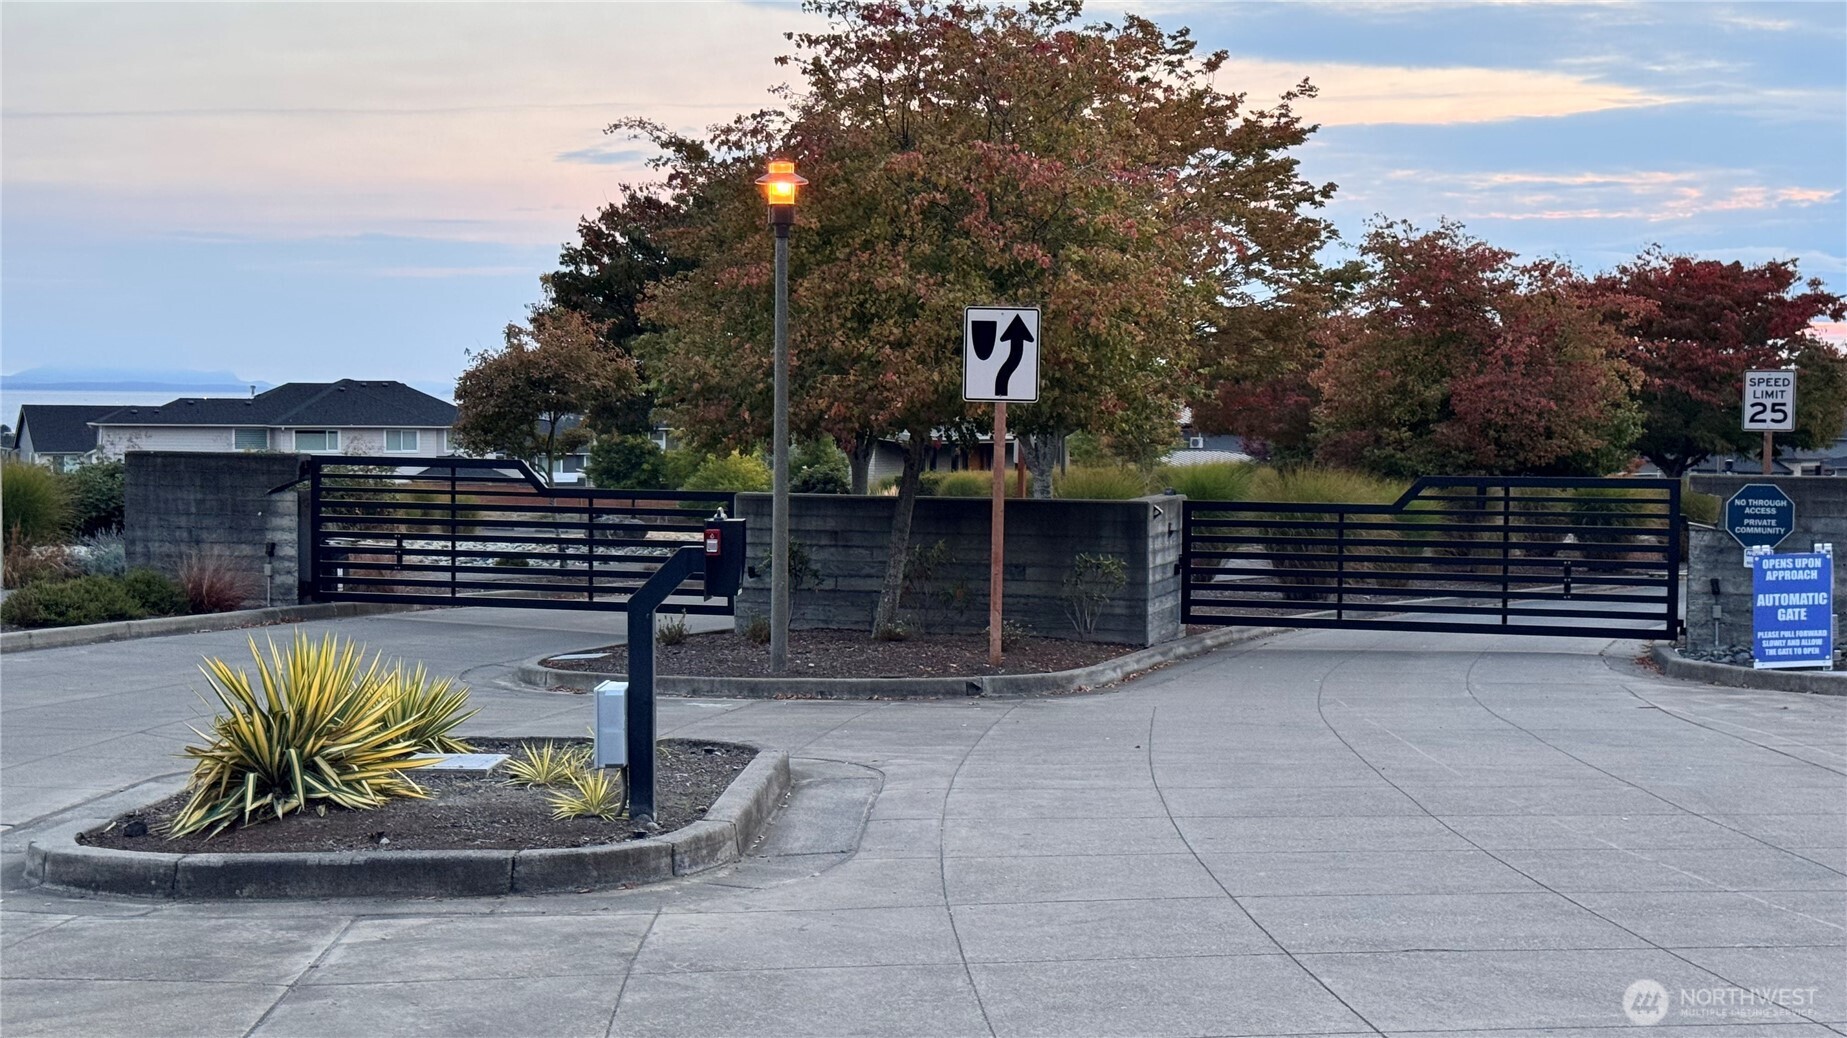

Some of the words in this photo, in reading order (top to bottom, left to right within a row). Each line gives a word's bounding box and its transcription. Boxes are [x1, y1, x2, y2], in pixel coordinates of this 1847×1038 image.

[1749, 377, 1791, 387] SPEED
[1753, 390, 1786, 399] LIMIT
[1748, 402, 1788, 424] 25
[1734, 498, 1746, 506] NO
[1748, 499, 1787, 507] THROUGH
[1744, 507, 1777, 515] ACCESS
[1743, 518, 1777, 526] PRIVATE
[1735, 526, 1785, 535] COMMUNITY
[1762, 558, 1793, 569] OPENS
[1795, 557, 1822, 568] UPON
[1765, 569, 1818, 581] APPROACH
[1756, 592, 1828, 607] AUTOMATIC
[1777, 608, 1807, 621] GATE
[1757, 631, 1779, 639] PLEASE
[1780, 630, 1795, 638] PULL
[1795, 629, 1828, 637] FORWARD
[1762, 639, 1786, 647] SLOWLY
[1801, 638, 1823, 646] ALLOW
[1765, 648, 1777, 656] THE
[1794, 647, 1802, 655] TO
[1802, 647, 1820, 655] OPEN
